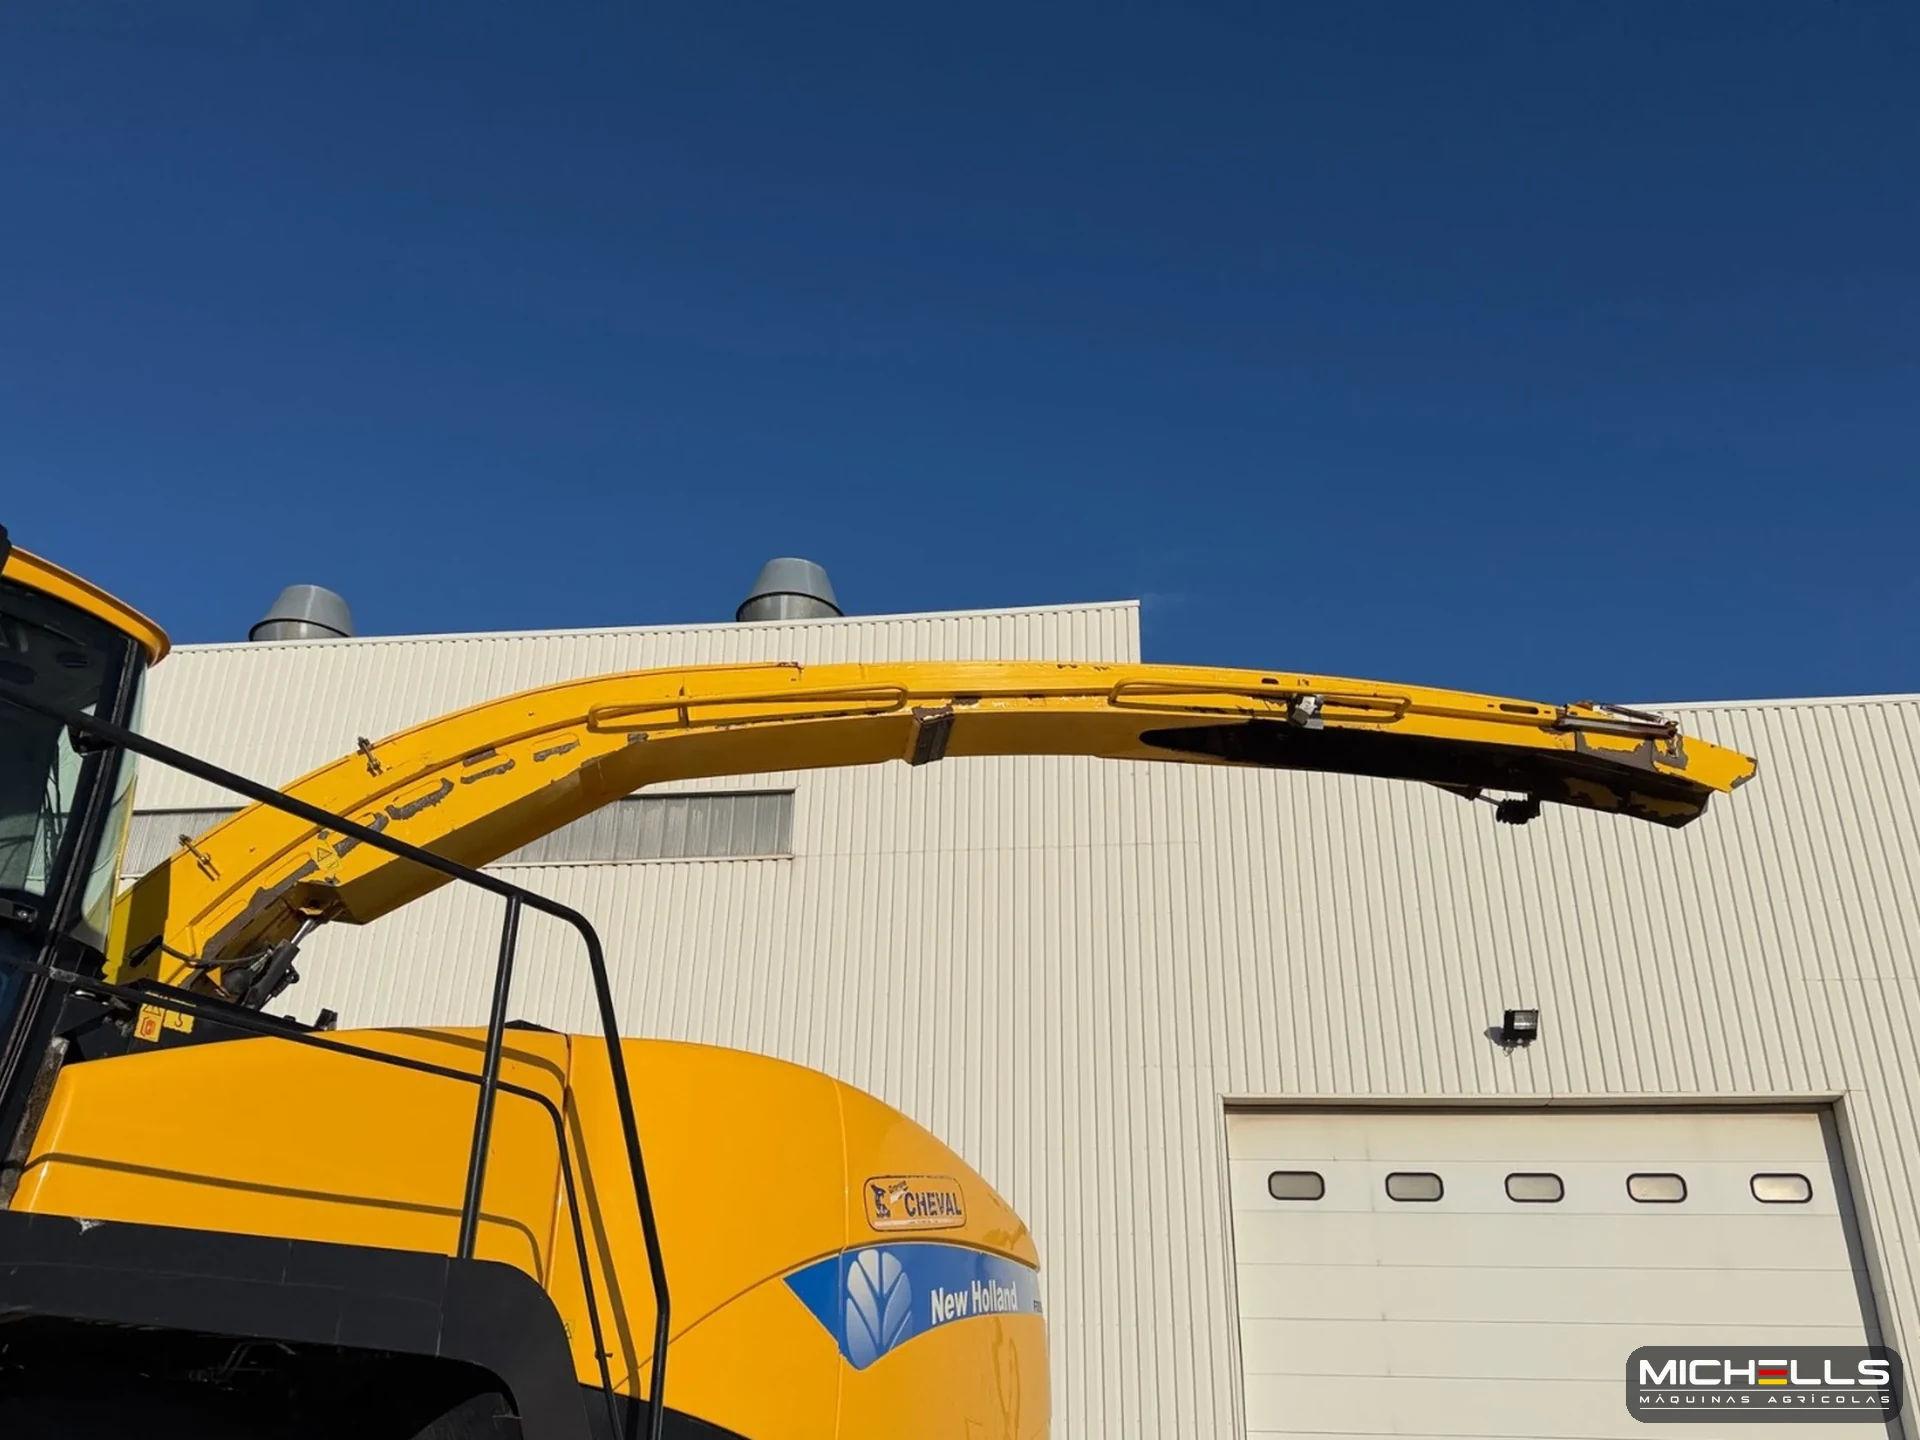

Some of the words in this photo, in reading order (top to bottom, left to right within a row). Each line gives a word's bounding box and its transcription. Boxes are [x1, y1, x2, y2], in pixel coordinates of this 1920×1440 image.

[904, 1192, 962, 1217] CHEVAL
[931, 1287, 968, 1325] New
[971, 1279, 1018, 1313] Holland
